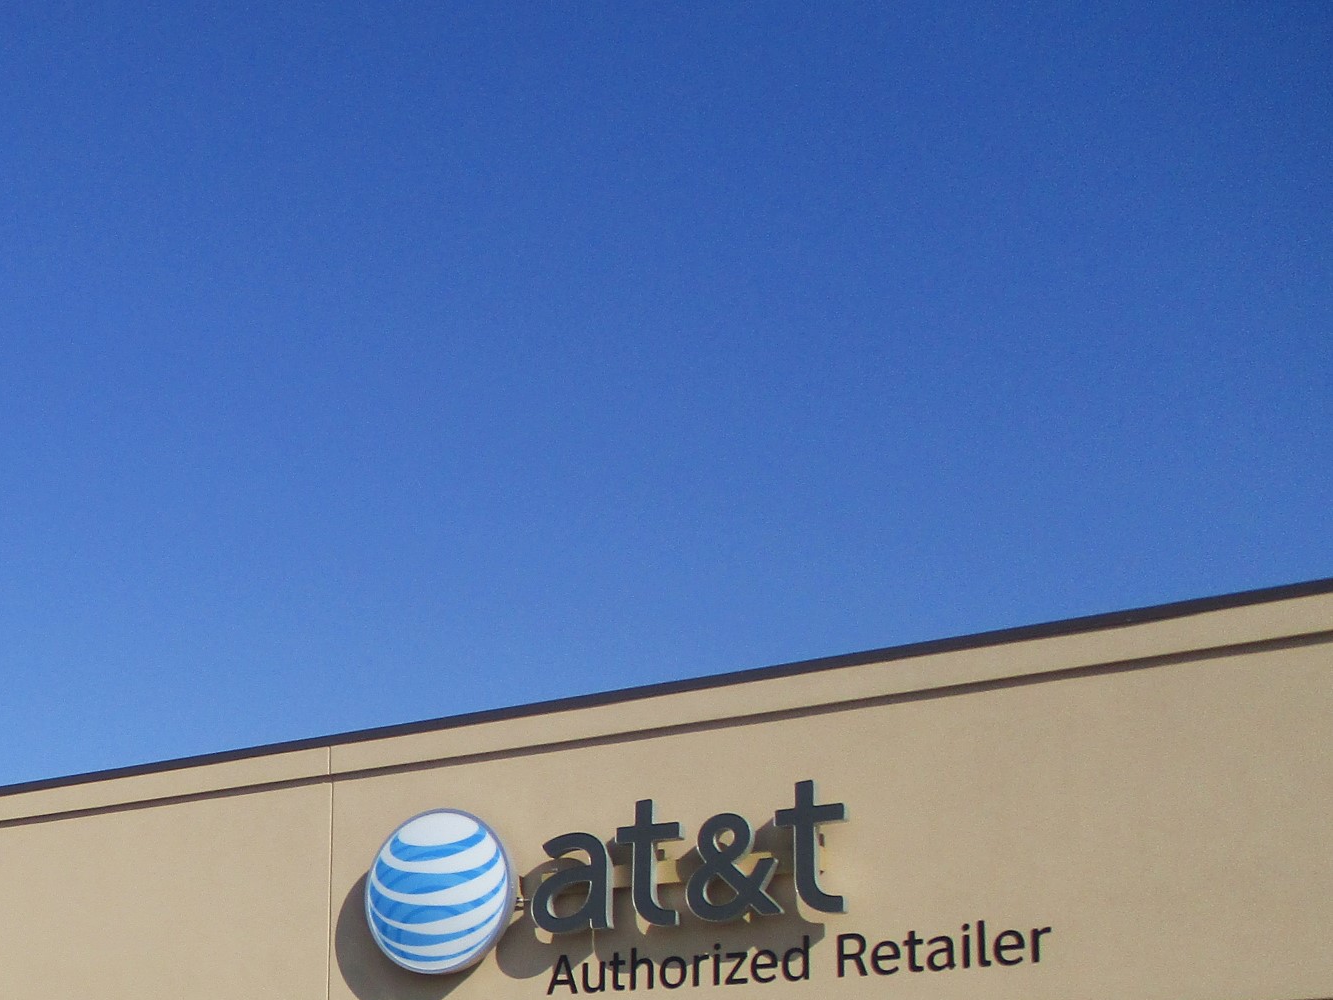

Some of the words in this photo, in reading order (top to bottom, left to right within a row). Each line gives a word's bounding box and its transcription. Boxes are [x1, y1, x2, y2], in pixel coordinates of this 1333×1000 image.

[531, 779, 846, 934] at&t
[547, 936, 812, 995] Authorized
[837, 920, 1052, 978] Retailer
